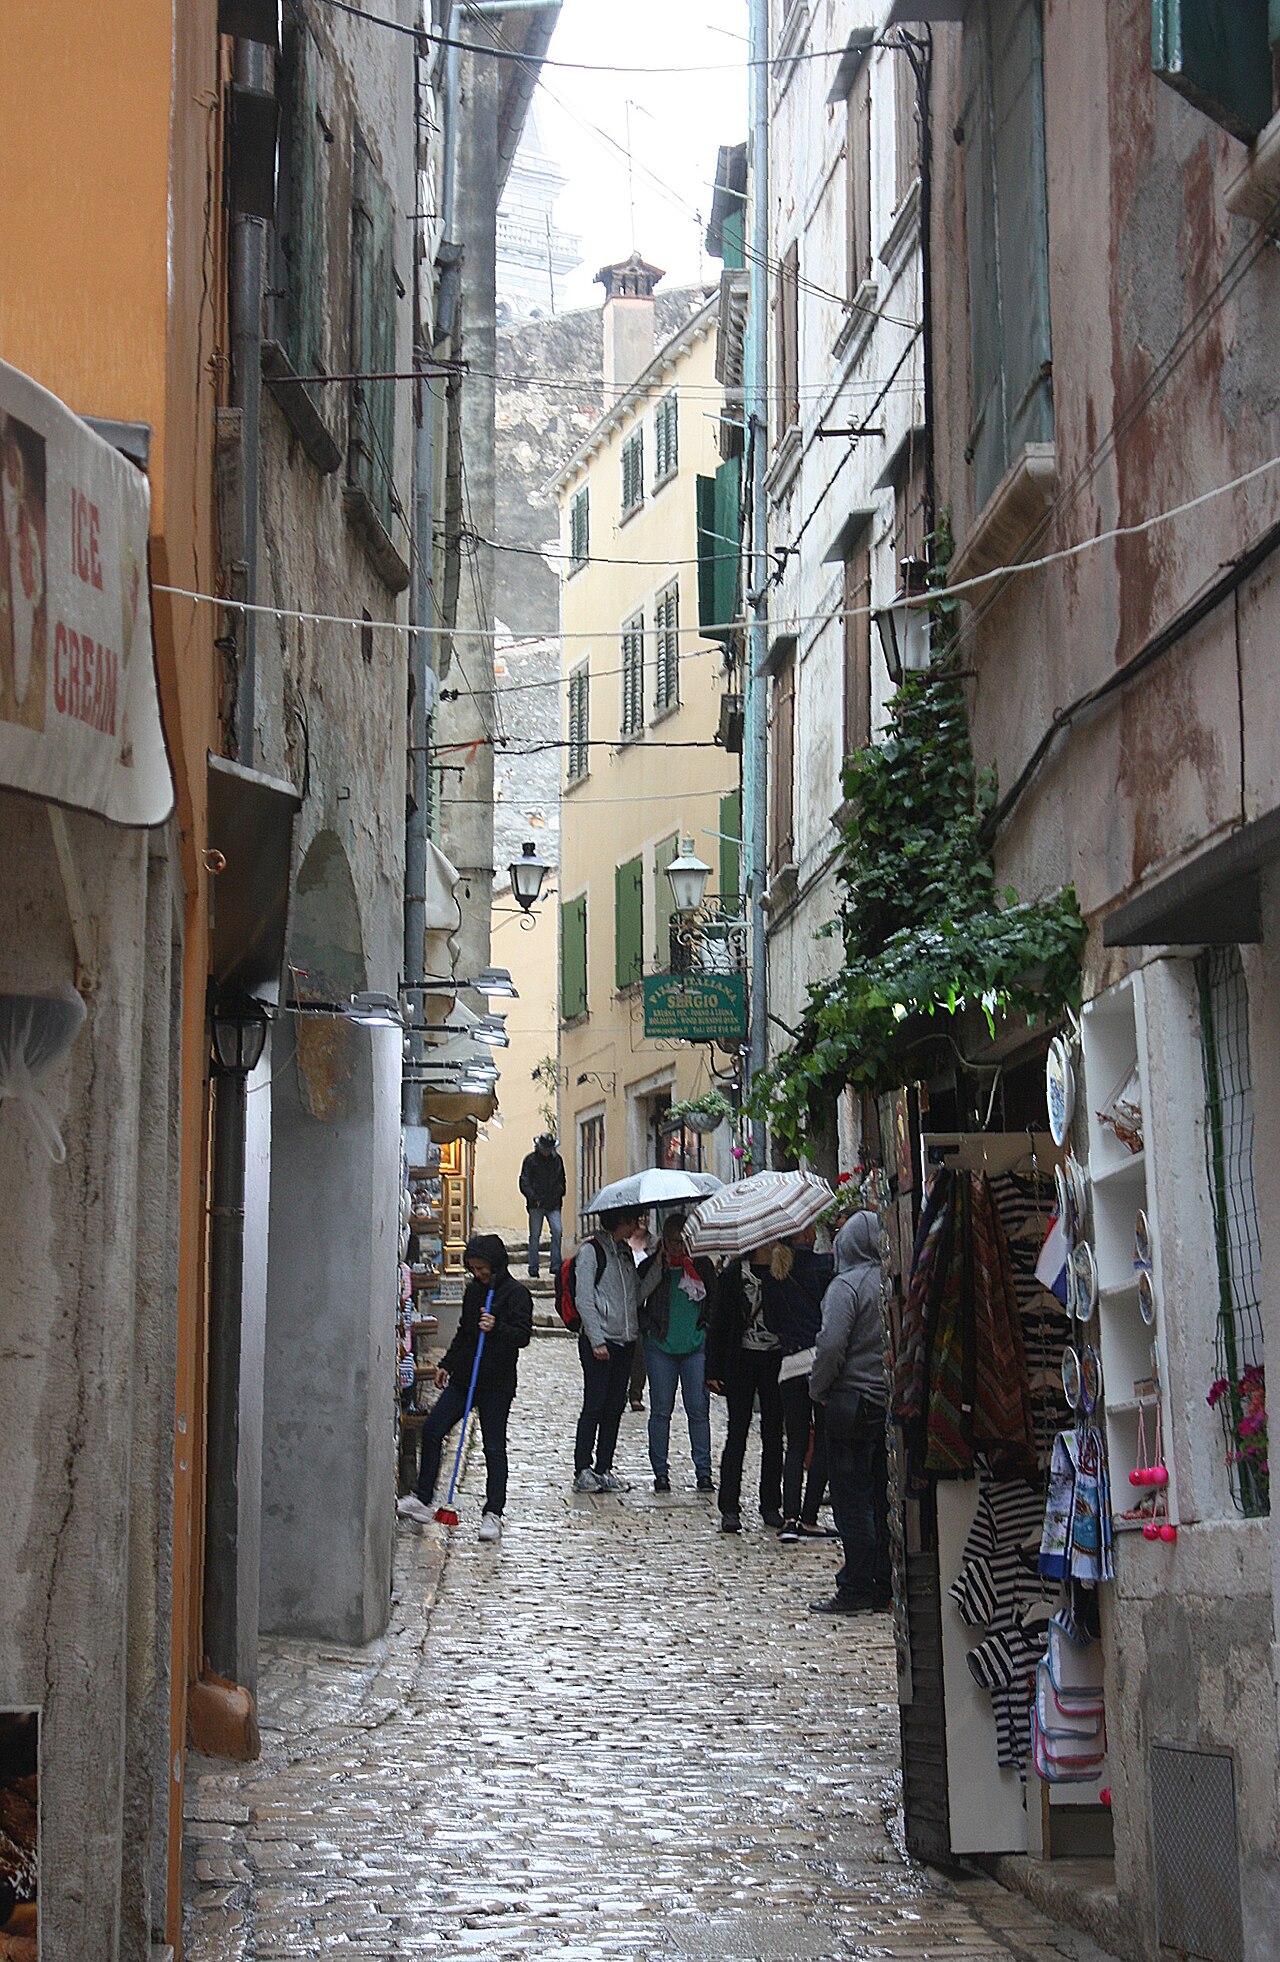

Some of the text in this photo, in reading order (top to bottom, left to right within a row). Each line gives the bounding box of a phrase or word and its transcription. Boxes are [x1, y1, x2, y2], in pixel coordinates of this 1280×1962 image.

[71, 487, 103, 590] ICE
[54, 621, 117, 736] CREAM
[649, 977, 737, 1004] PIZZA ITALIANA
[667, 994, 719, 1009] SERGIO
